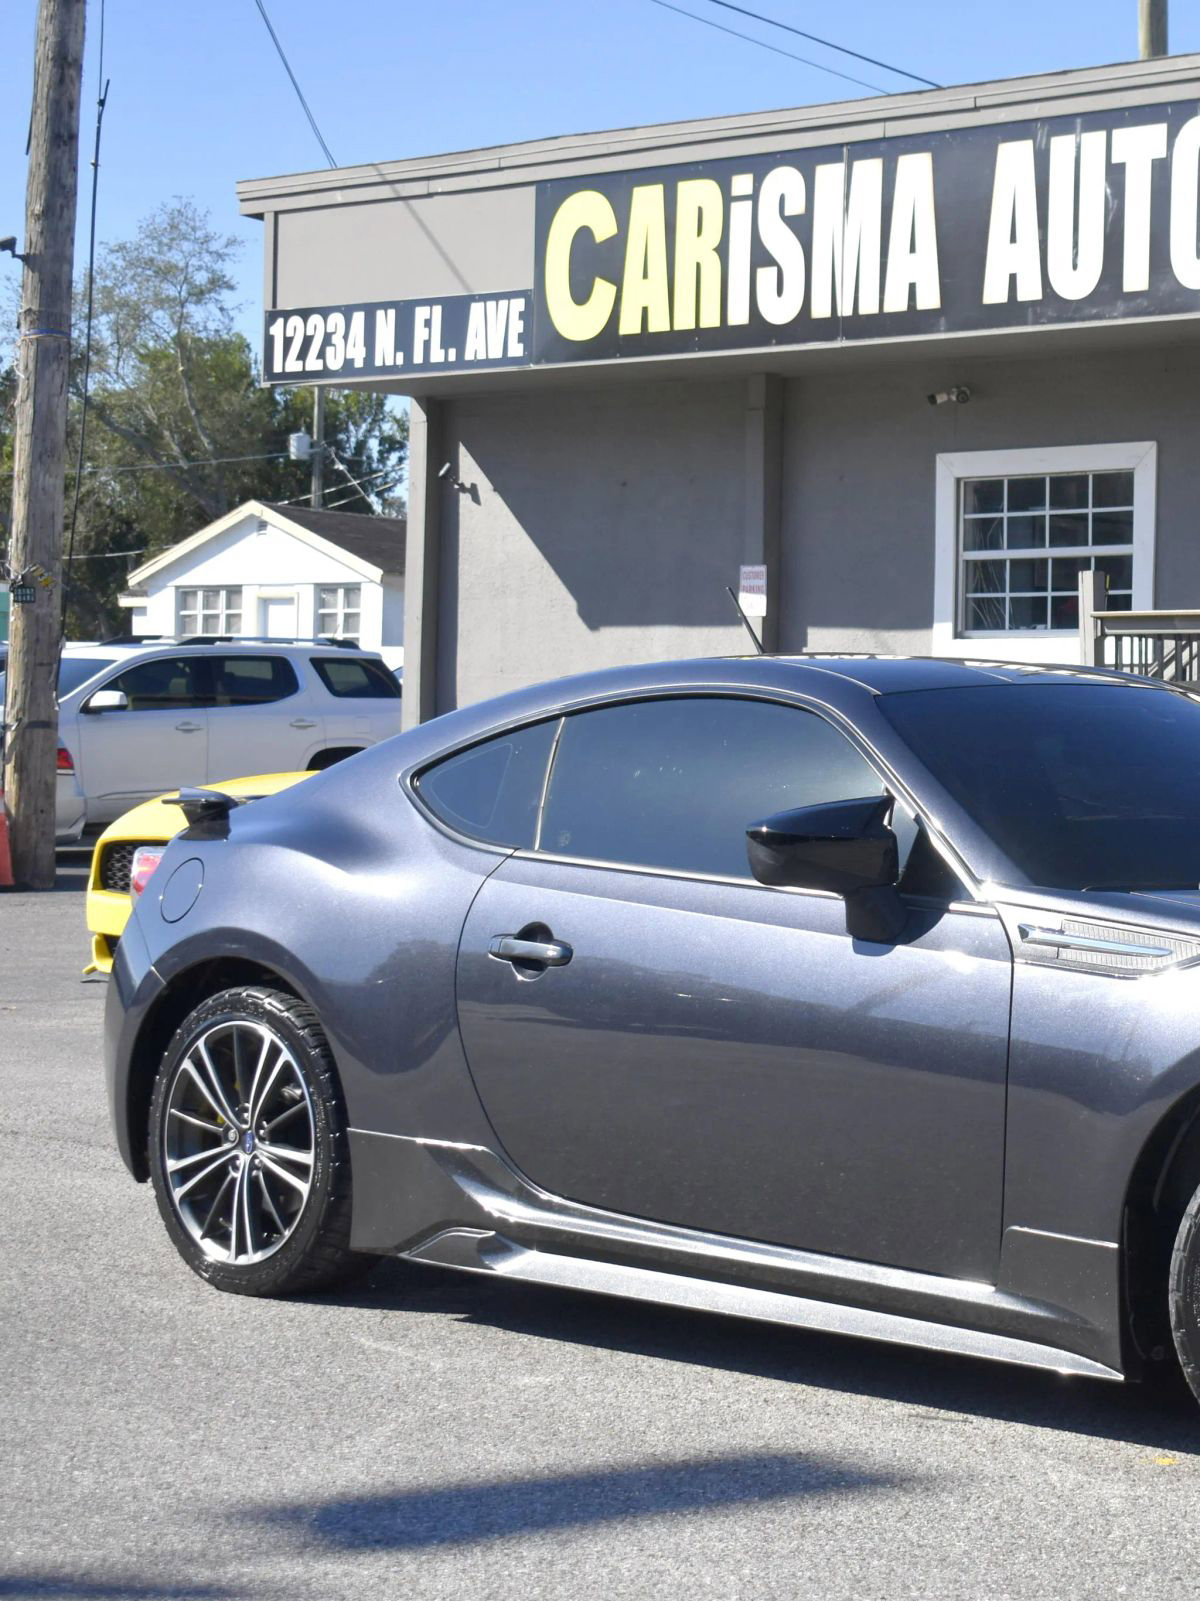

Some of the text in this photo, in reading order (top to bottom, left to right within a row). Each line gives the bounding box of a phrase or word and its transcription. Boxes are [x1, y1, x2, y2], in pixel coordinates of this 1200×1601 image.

[269, 298, 525, 373] 12234 N. FL. AVE
